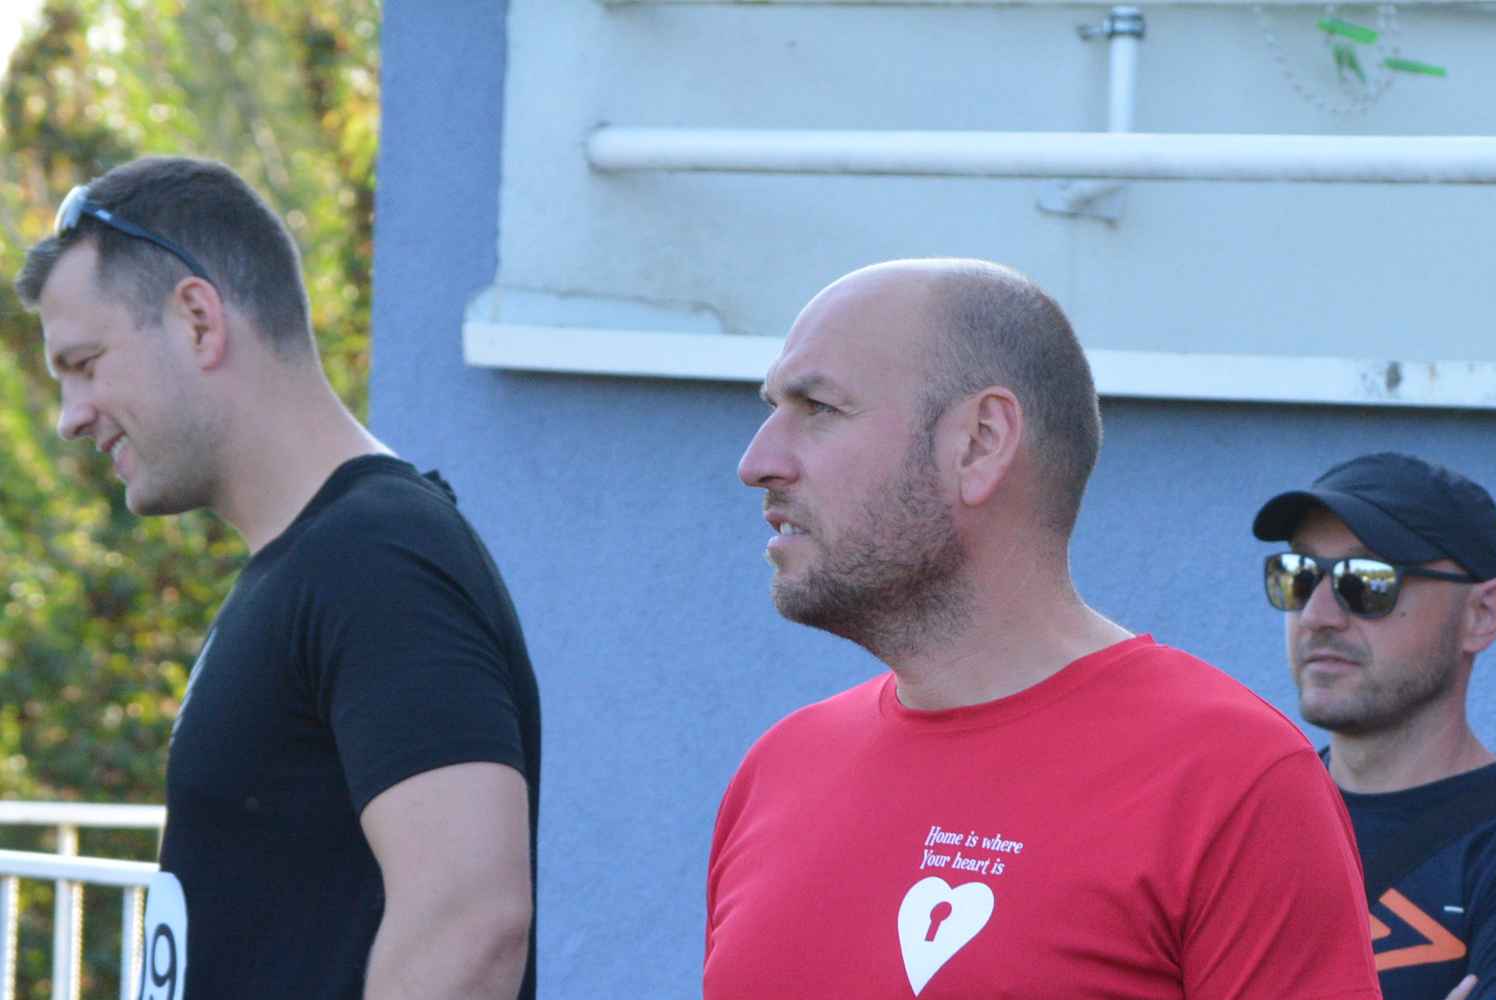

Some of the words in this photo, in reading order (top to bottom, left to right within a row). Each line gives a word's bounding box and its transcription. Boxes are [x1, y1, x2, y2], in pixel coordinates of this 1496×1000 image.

[924, 825, 964, 847] Home
[964, 830, 979, 848] is
[981, 833, 1024, 854] where
[919, 849, 951, 870] Your
[951, 851, 991, 875] heart
[990, 858, 1005, 875] is
